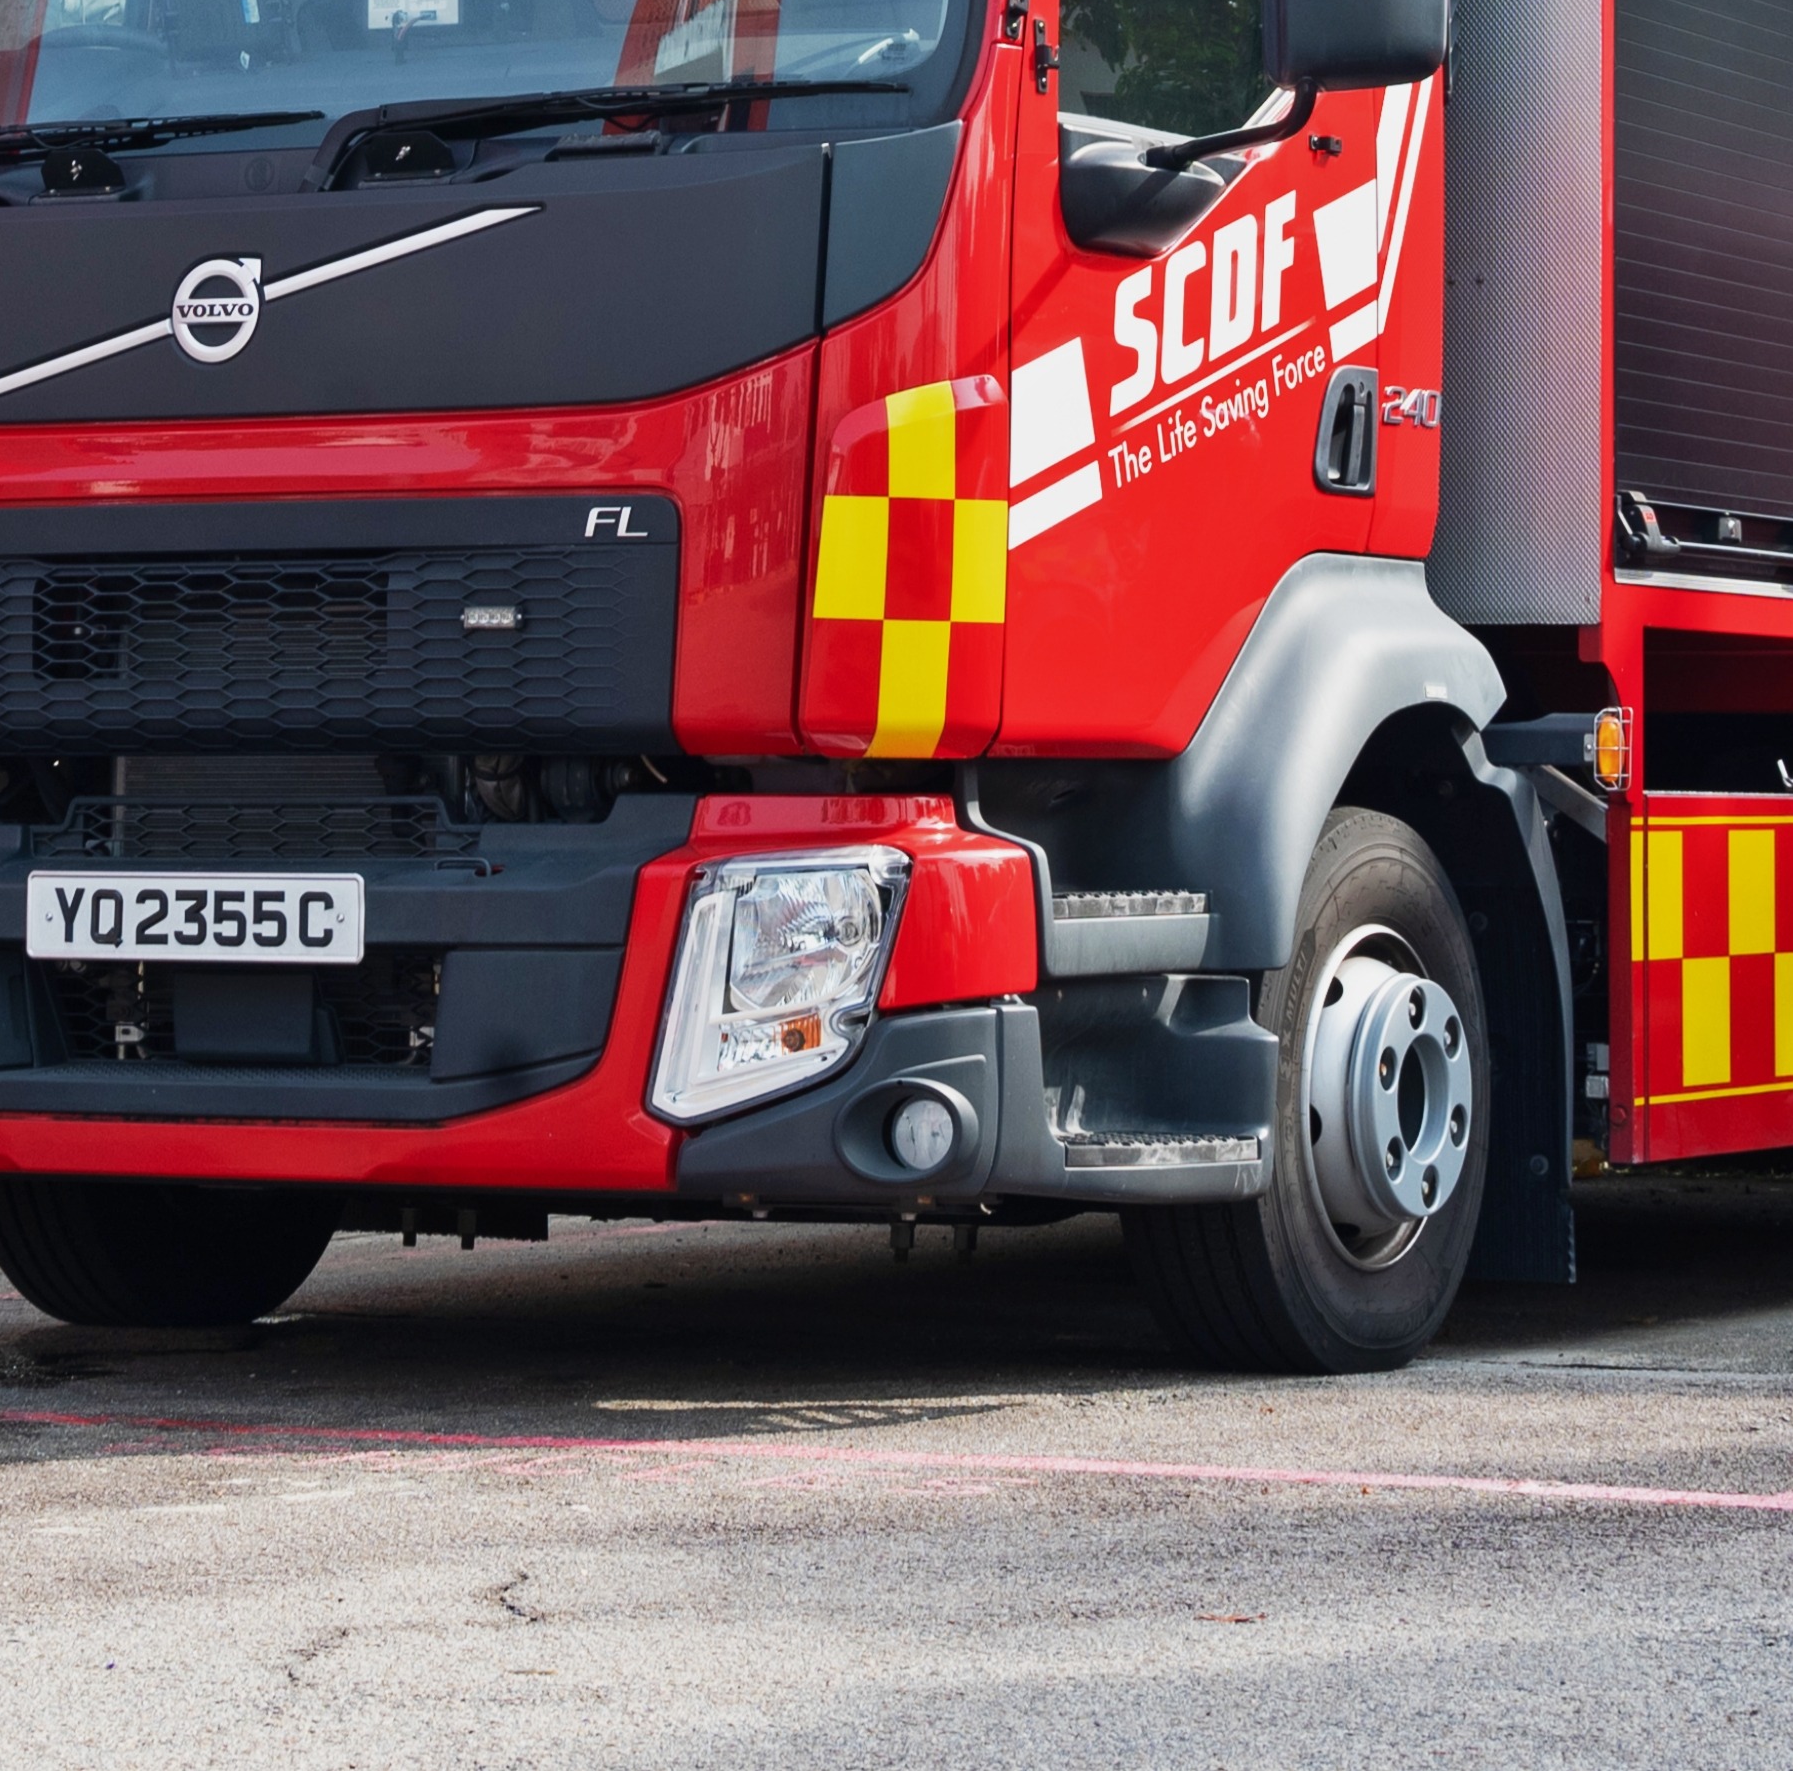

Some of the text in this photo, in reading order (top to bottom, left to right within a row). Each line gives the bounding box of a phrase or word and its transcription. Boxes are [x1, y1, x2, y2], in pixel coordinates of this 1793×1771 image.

[176, 303, 254, 319] VOLVO
[1109, 189, 1297, 417] SCDF
[1108, 345, 1326, 488] The Life Saving Force
[1382, 385, 1443, 427] 240
[584, 506, 648, 537] FL
[55, 887, 335, 948] YQ2355C
